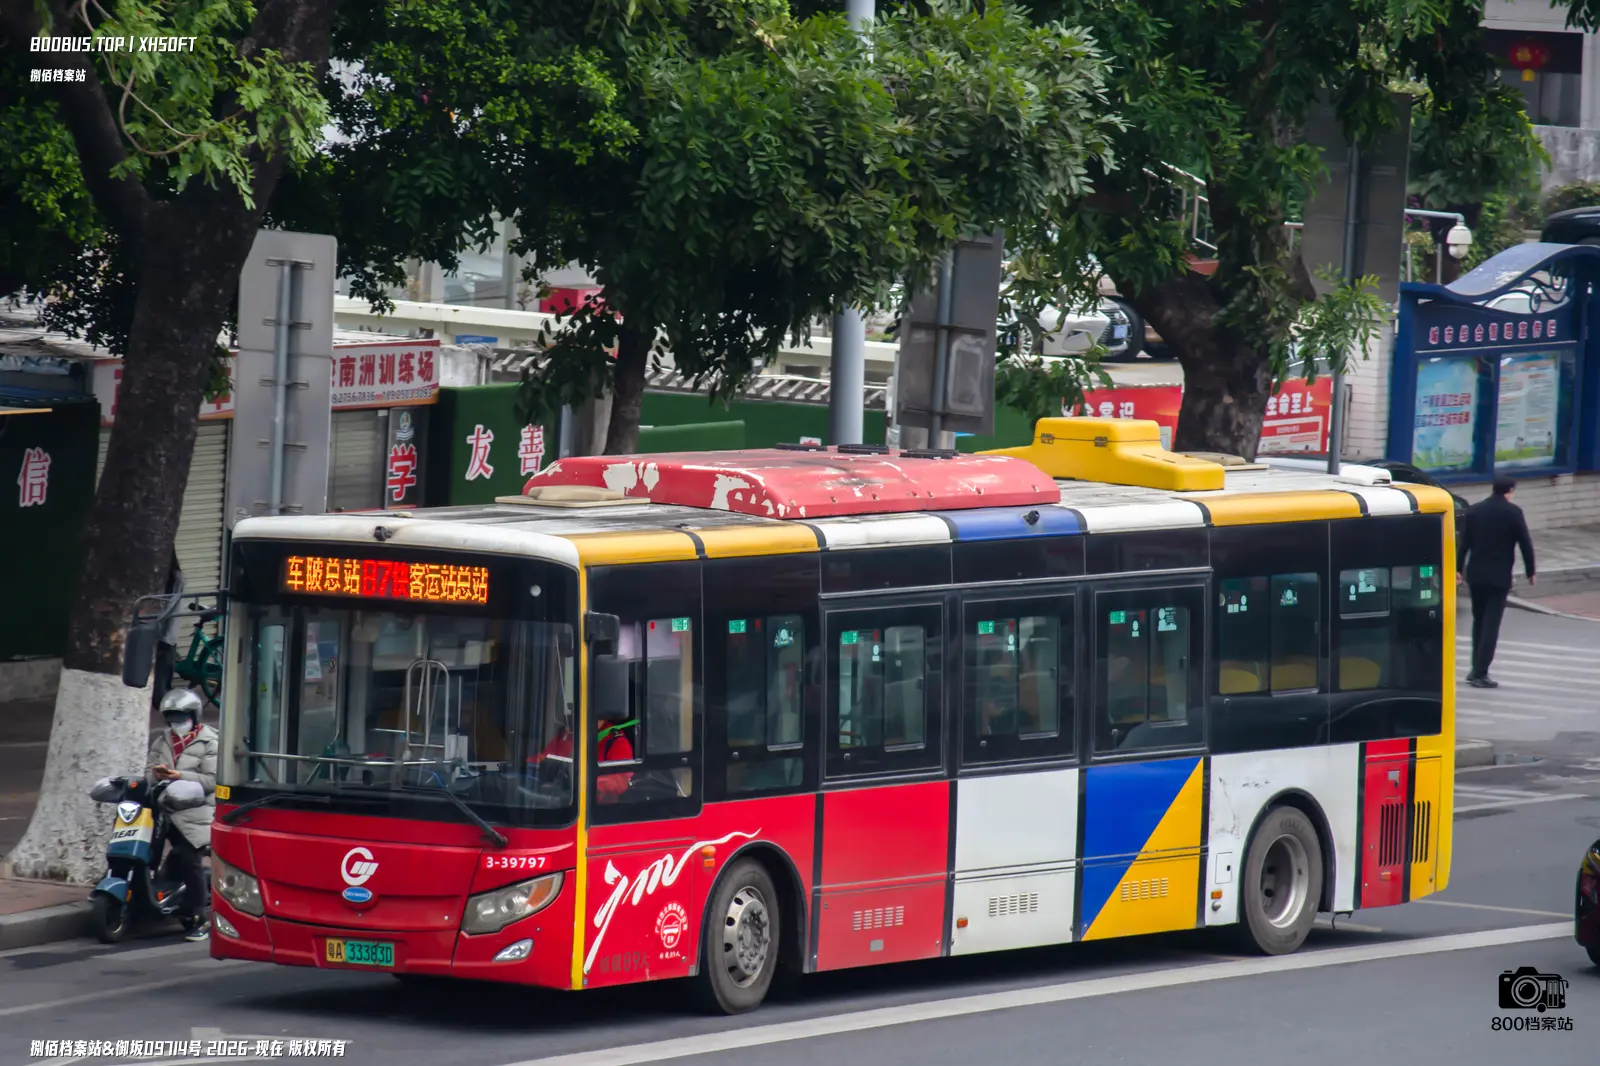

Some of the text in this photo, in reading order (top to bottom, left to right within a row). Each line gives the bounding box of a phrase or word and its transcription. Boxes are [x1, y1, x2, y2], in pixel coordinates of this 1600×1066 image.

[332, 351, 434, 388] 南洲训练场
[17, 446, 52, 507] 信
[388, 443, 417, 501] 学
[465, 423, 545, 481] 友善
[287, 556, 361, 594] 车陂总站
[409, 563, 489, 604] 客运站总站
[486, 856, 547, 869] 3-39797
